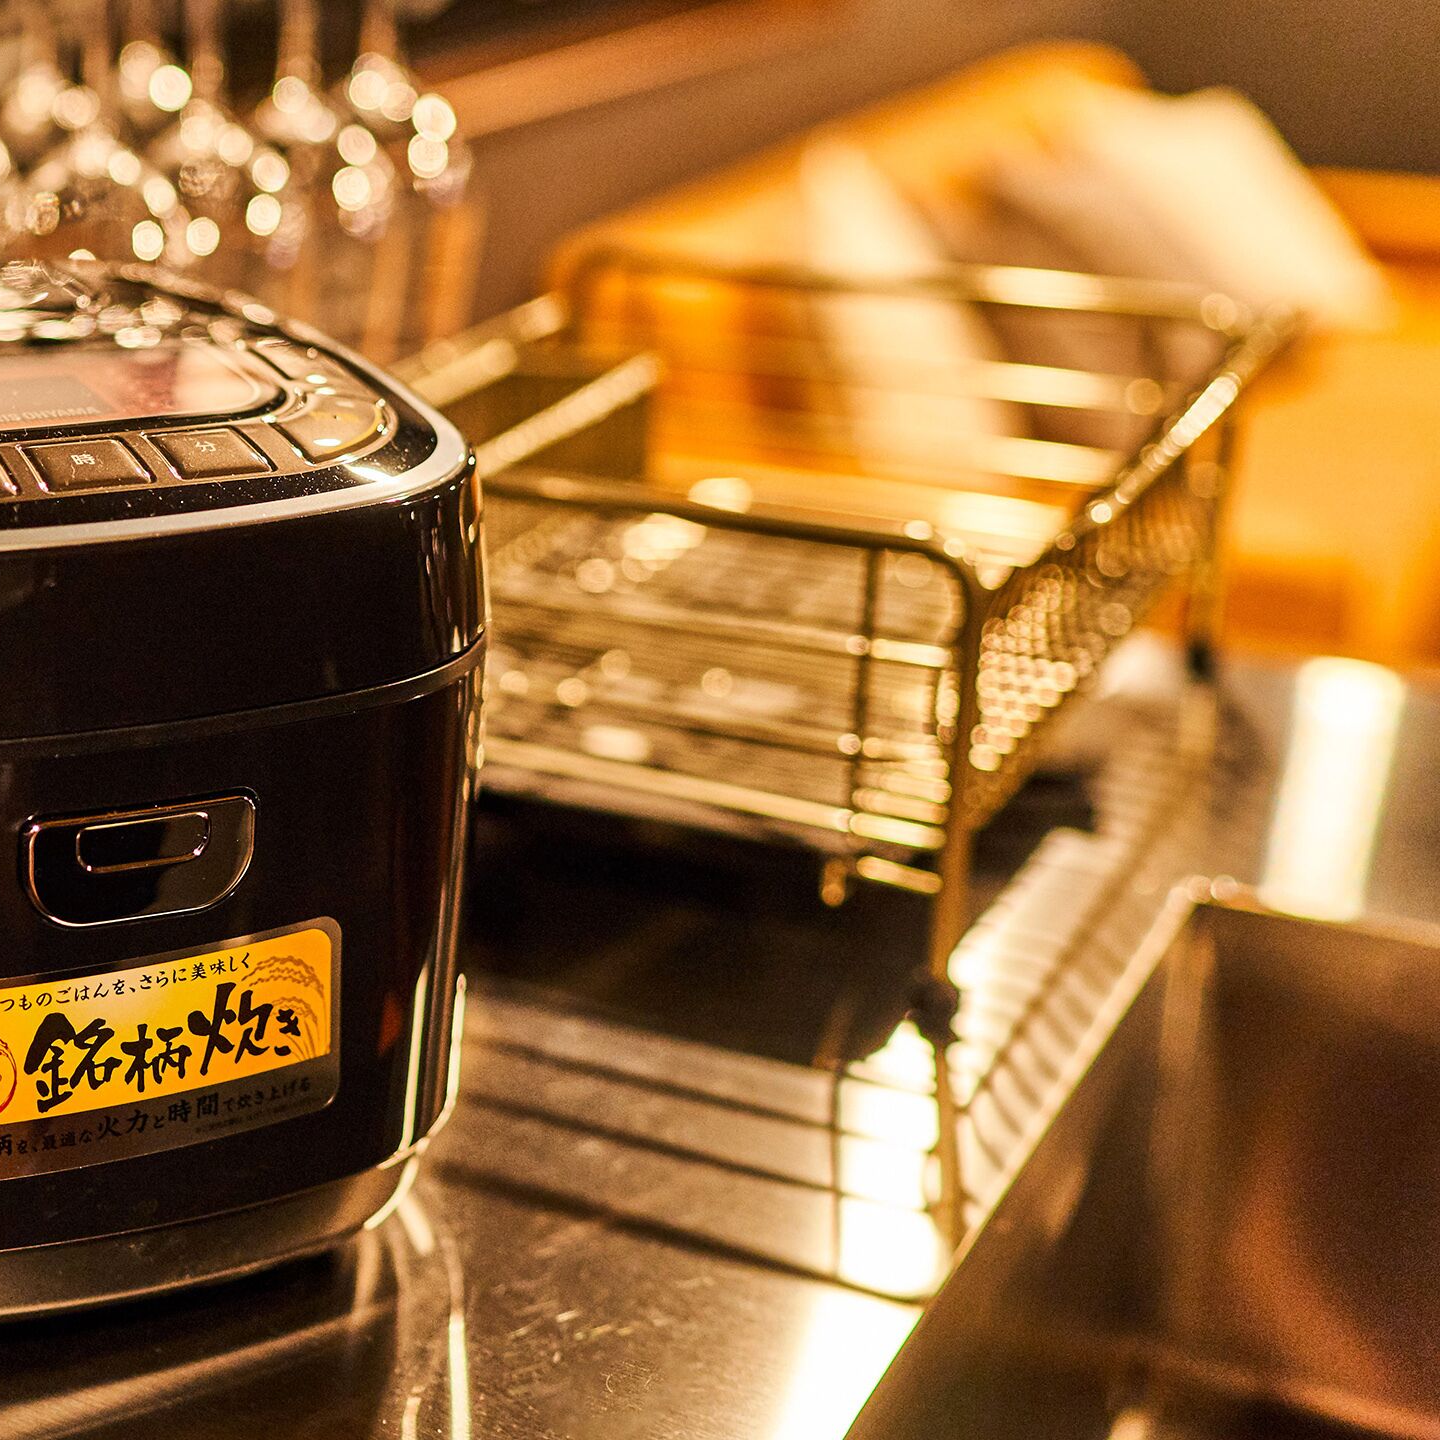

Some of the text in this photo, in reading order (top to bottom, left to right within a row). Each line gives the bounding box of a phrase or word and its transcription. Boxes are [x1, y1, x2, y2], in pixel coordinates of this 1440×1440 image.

[23, 405, 101, 421] OHYAMA
[70, 453, 96, 466] 時
[23, 981, 302, 1114] 銘柄炊き
